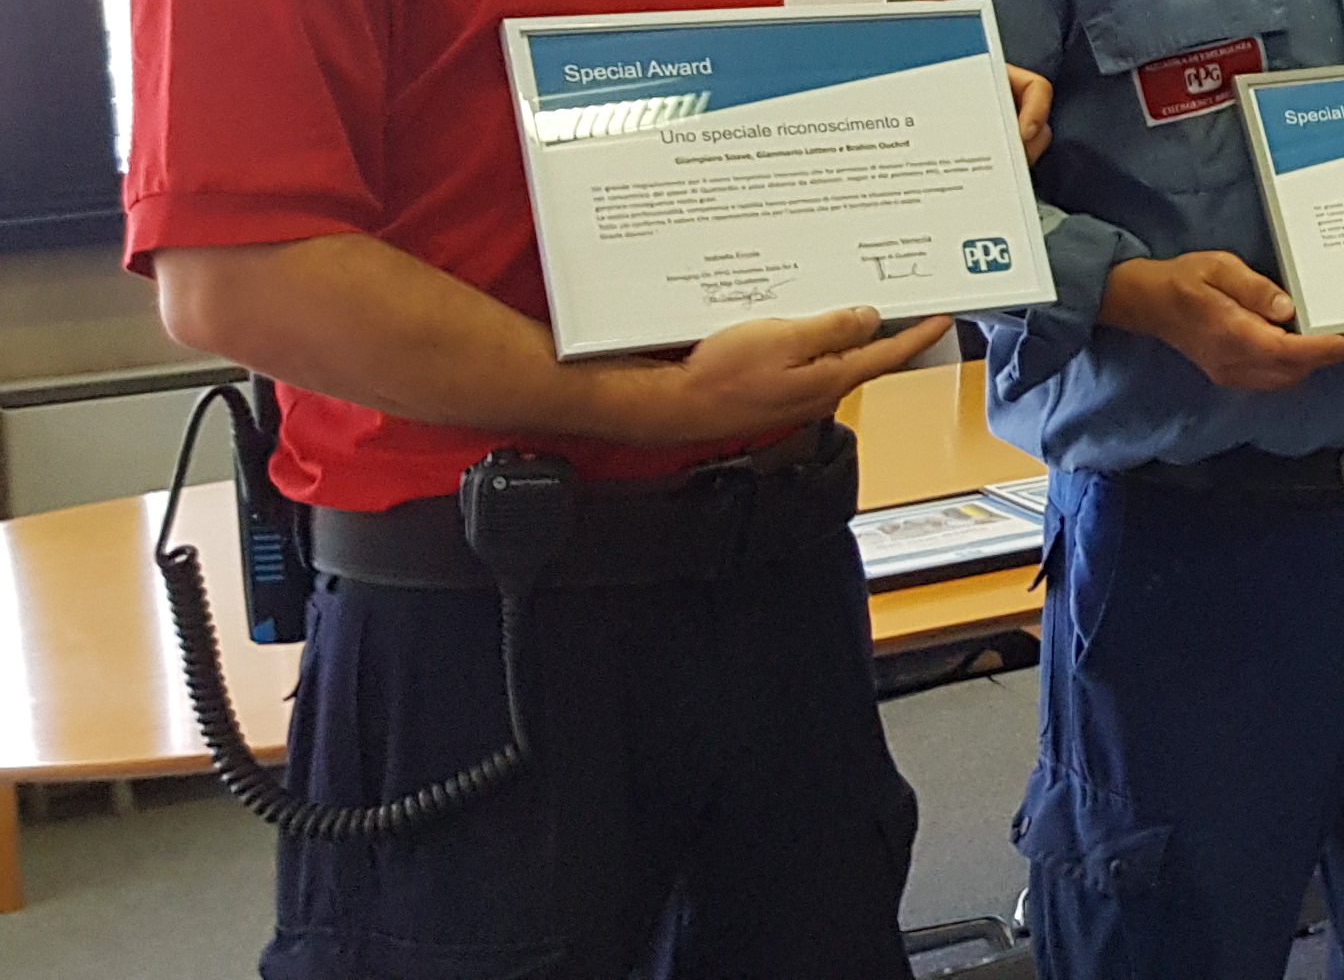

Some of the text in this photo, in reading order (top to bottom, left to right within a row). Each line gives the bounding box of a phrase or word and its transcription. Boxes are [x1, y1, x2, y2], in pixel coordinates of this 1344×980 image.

[563, 57, 713, 85] Special Award
[1187, 65, 1220, 87] PPG
[660, 116, 915, 144] Uno speciale riconoscimento a
[964, 240, 1010, 271] PPG
